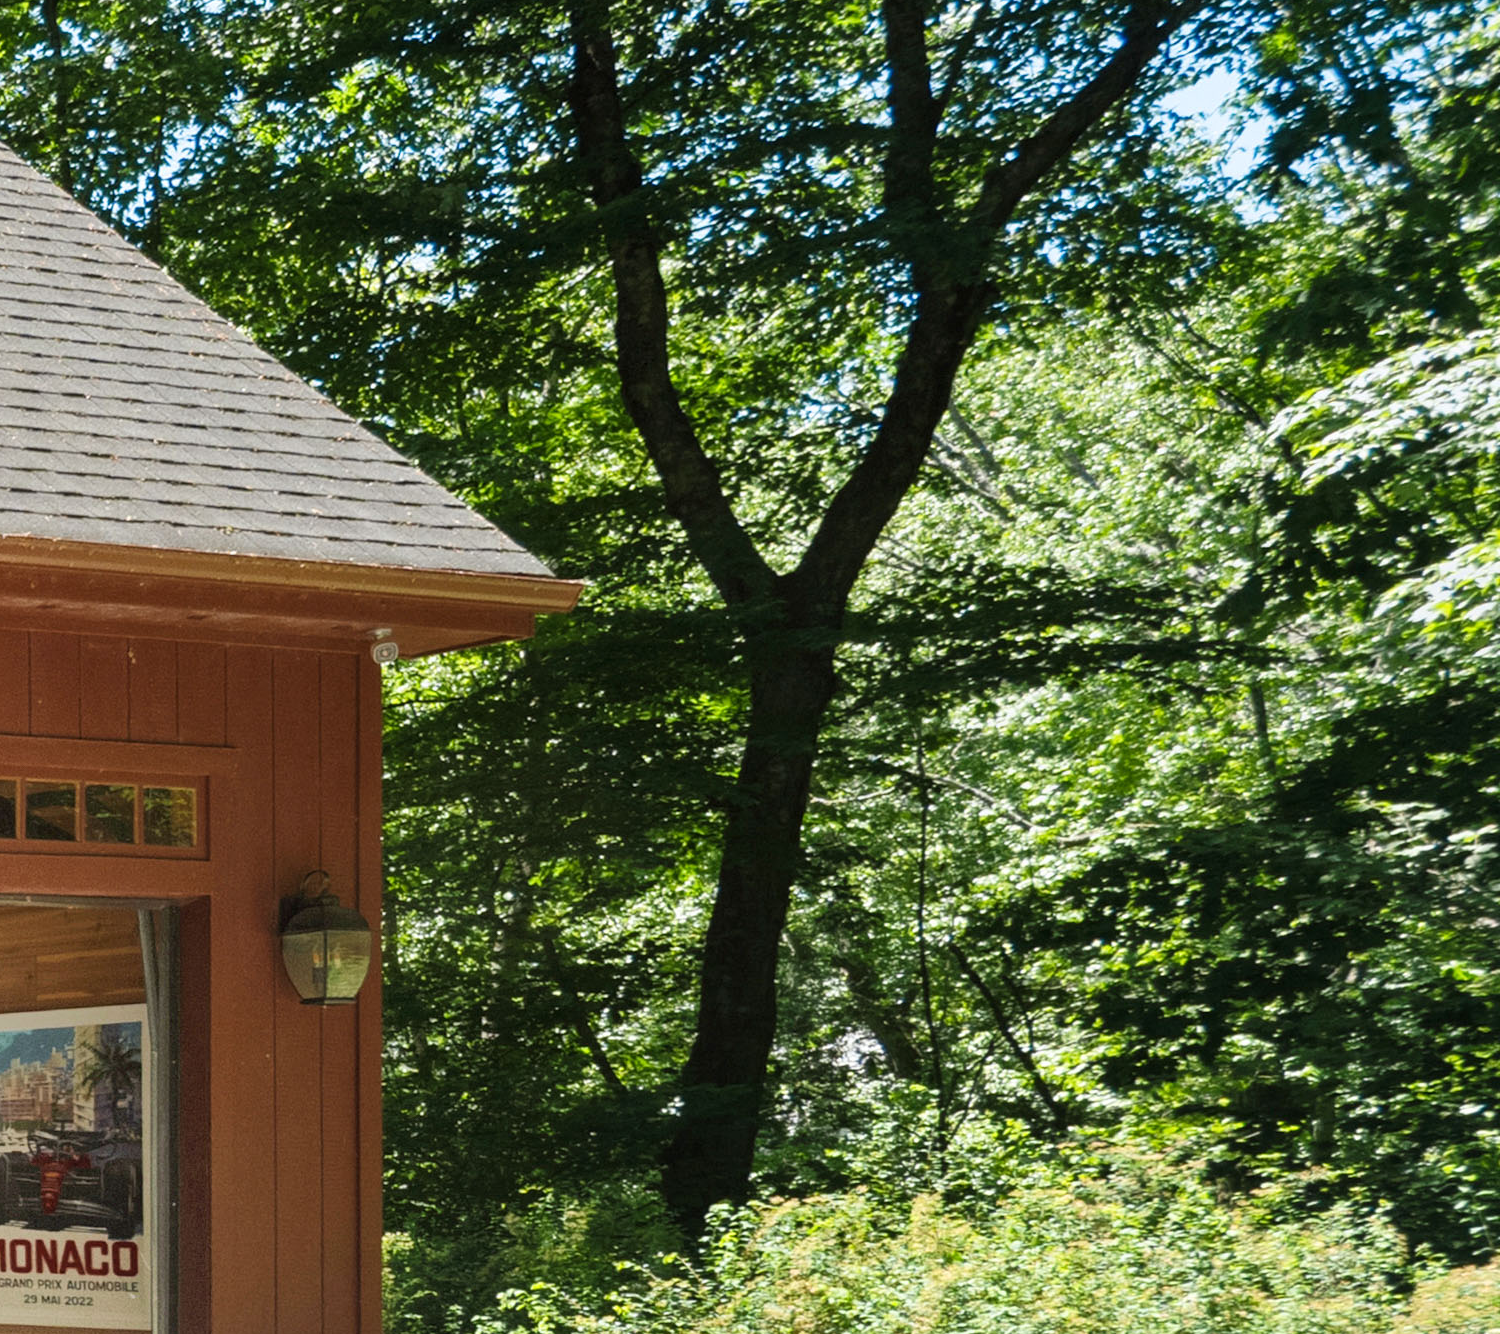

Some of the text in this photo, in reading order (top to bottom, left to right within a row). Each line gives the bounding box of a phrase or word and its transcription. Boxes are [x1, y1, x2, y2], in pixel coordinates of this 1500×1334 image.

[38, 1279, 62, 1290] PRIX
[67, 1280, 139, 1293] AUTOMOBILE
[24, 1294, 94, 1306] 29 MAI 2022
